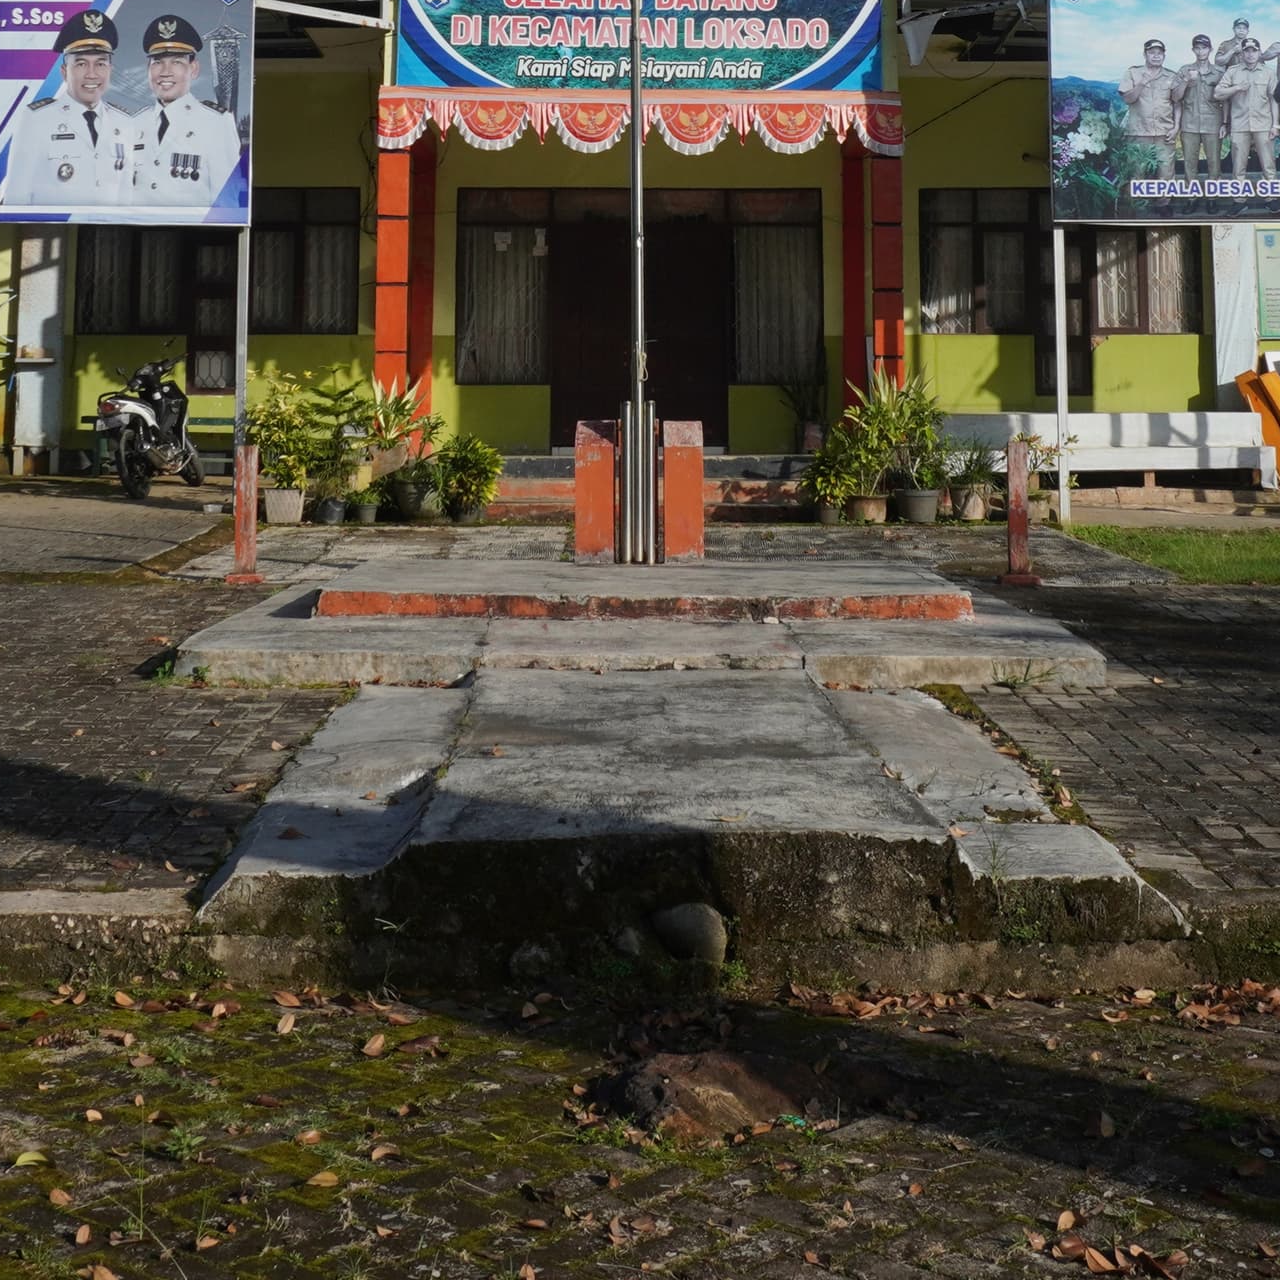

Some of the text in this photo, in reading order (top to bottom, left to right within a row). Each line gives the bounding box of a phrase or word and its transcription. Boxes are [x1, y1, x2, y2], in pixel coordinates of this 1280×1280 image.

[11, 8, 65, 26] S.Sos
[450, 15, 829, 50] DI KECAMATAN LOKSADO
[516, 56, 763, 82] Kami Siap Melayani Anda
[1131, 180, 1203, 198] KEPALA
[1206, 180, 1253, 198] DESA
[1258, 180, 1280, 197] SE
